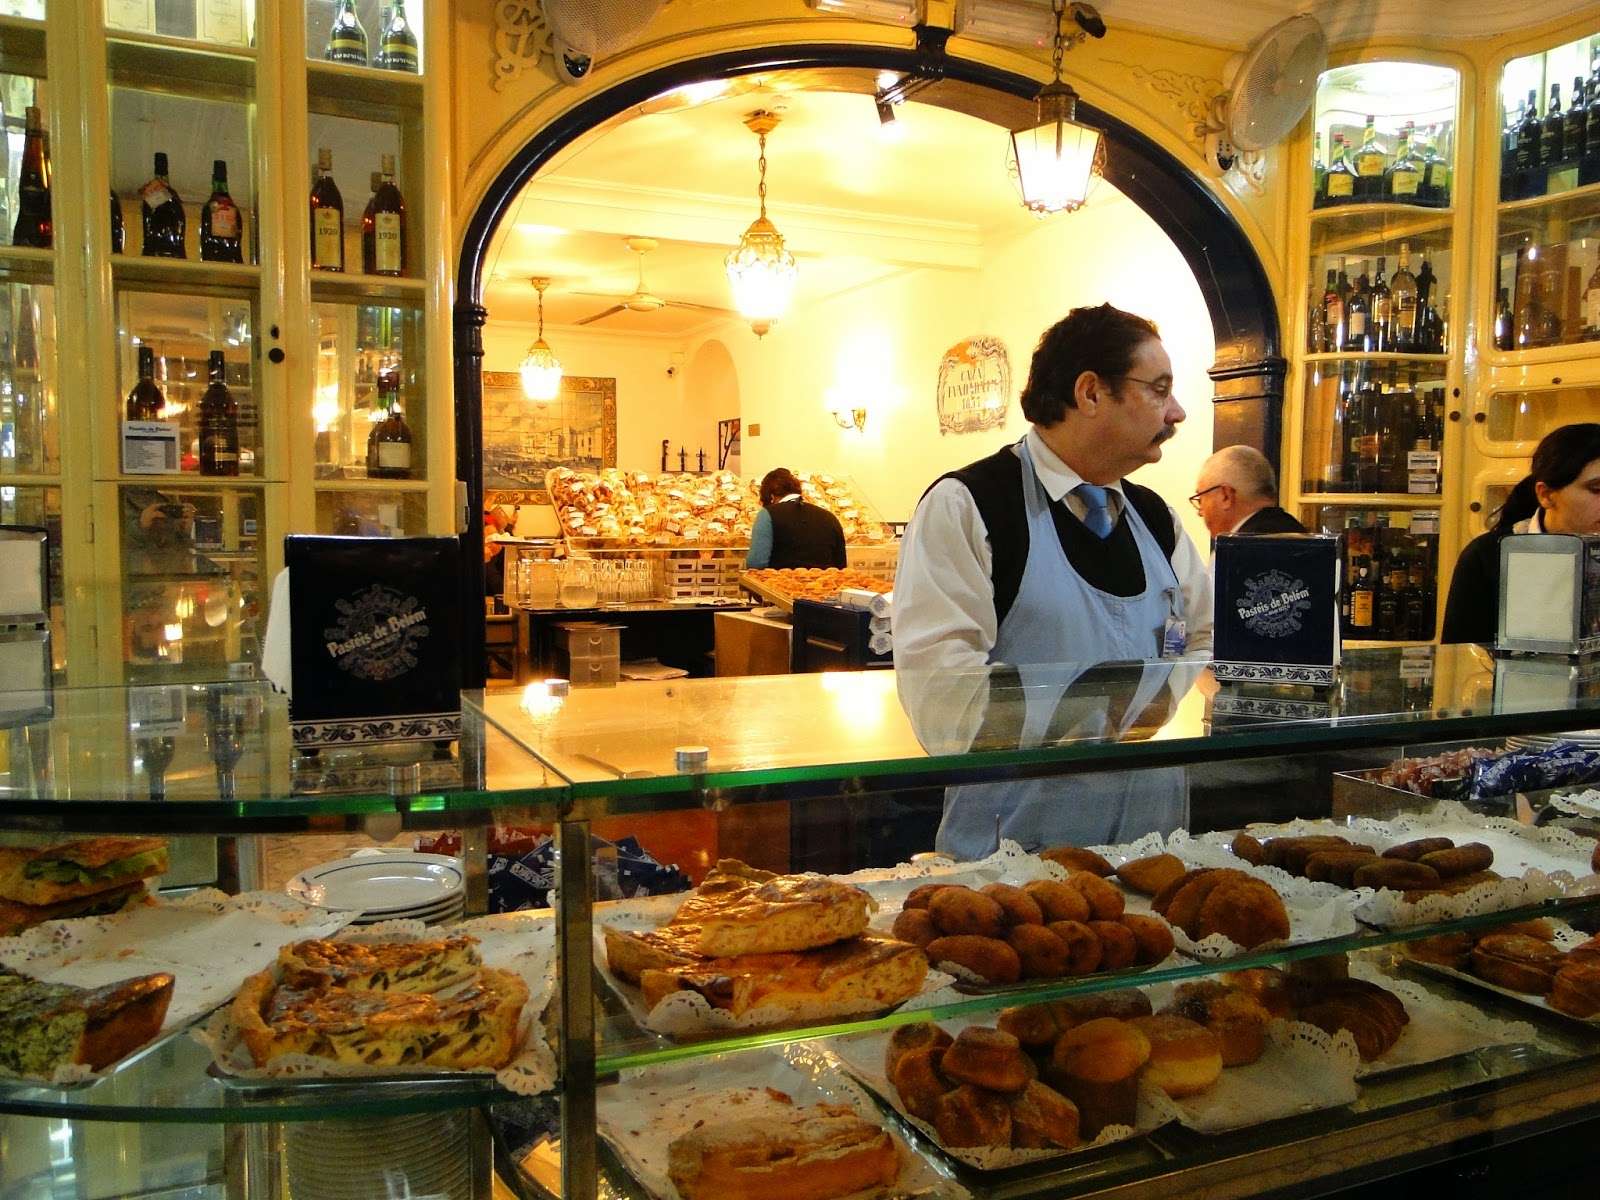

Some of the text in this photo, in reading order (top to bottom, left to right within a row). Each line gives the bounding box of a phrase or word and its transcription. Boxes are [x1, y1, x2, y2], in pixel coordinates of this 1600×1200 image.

[318, 226, 338, 236] 1920
[378, 231, 397, 240] 1920
[1238, 602, 1269, 619] Pastéis
[1270, 598, 1281, 609] de
[1280, 589, 1310, 605] Belém
[327, 631, 372, 658] Pastéis
[373, 625, 388, 640] de
[387, 610, 427, 633] Belém
